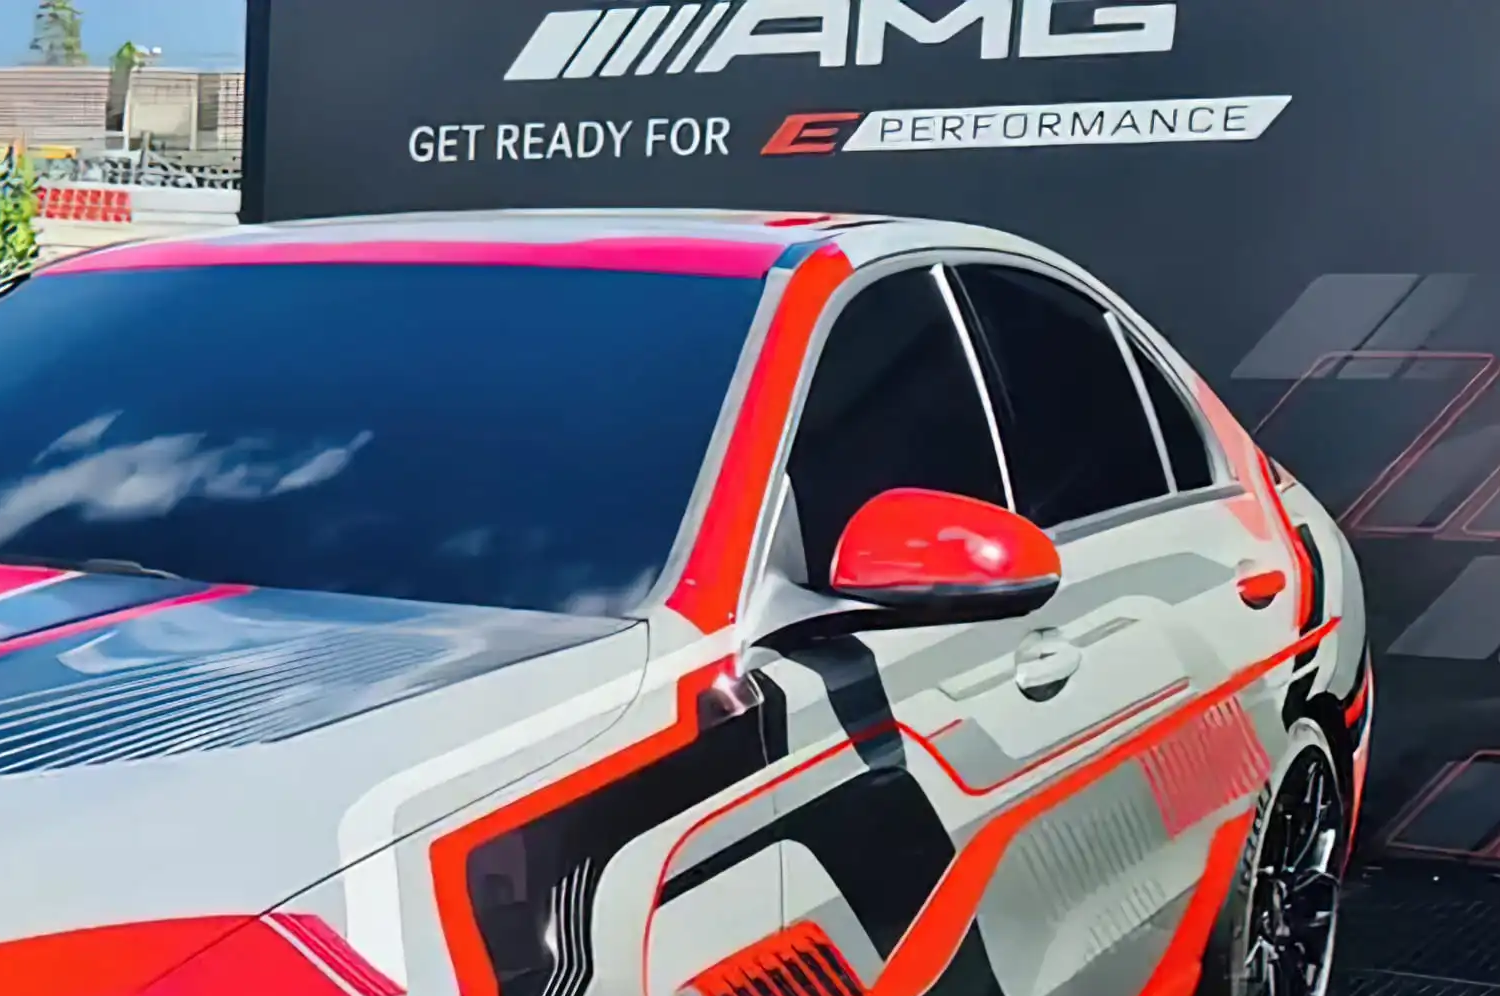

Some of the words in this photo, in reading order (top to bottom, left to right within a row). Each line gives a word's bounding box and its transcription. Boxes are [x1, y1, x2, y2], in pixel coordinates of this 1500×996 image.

[694, 0, 1178, 73] AMG
[408, 124, 486, 162] GET
[495, 119, 633, 161] READY
[645, 116, 731, 158] FOR
[879, 104, 1250, 143] PERFORMANCE
